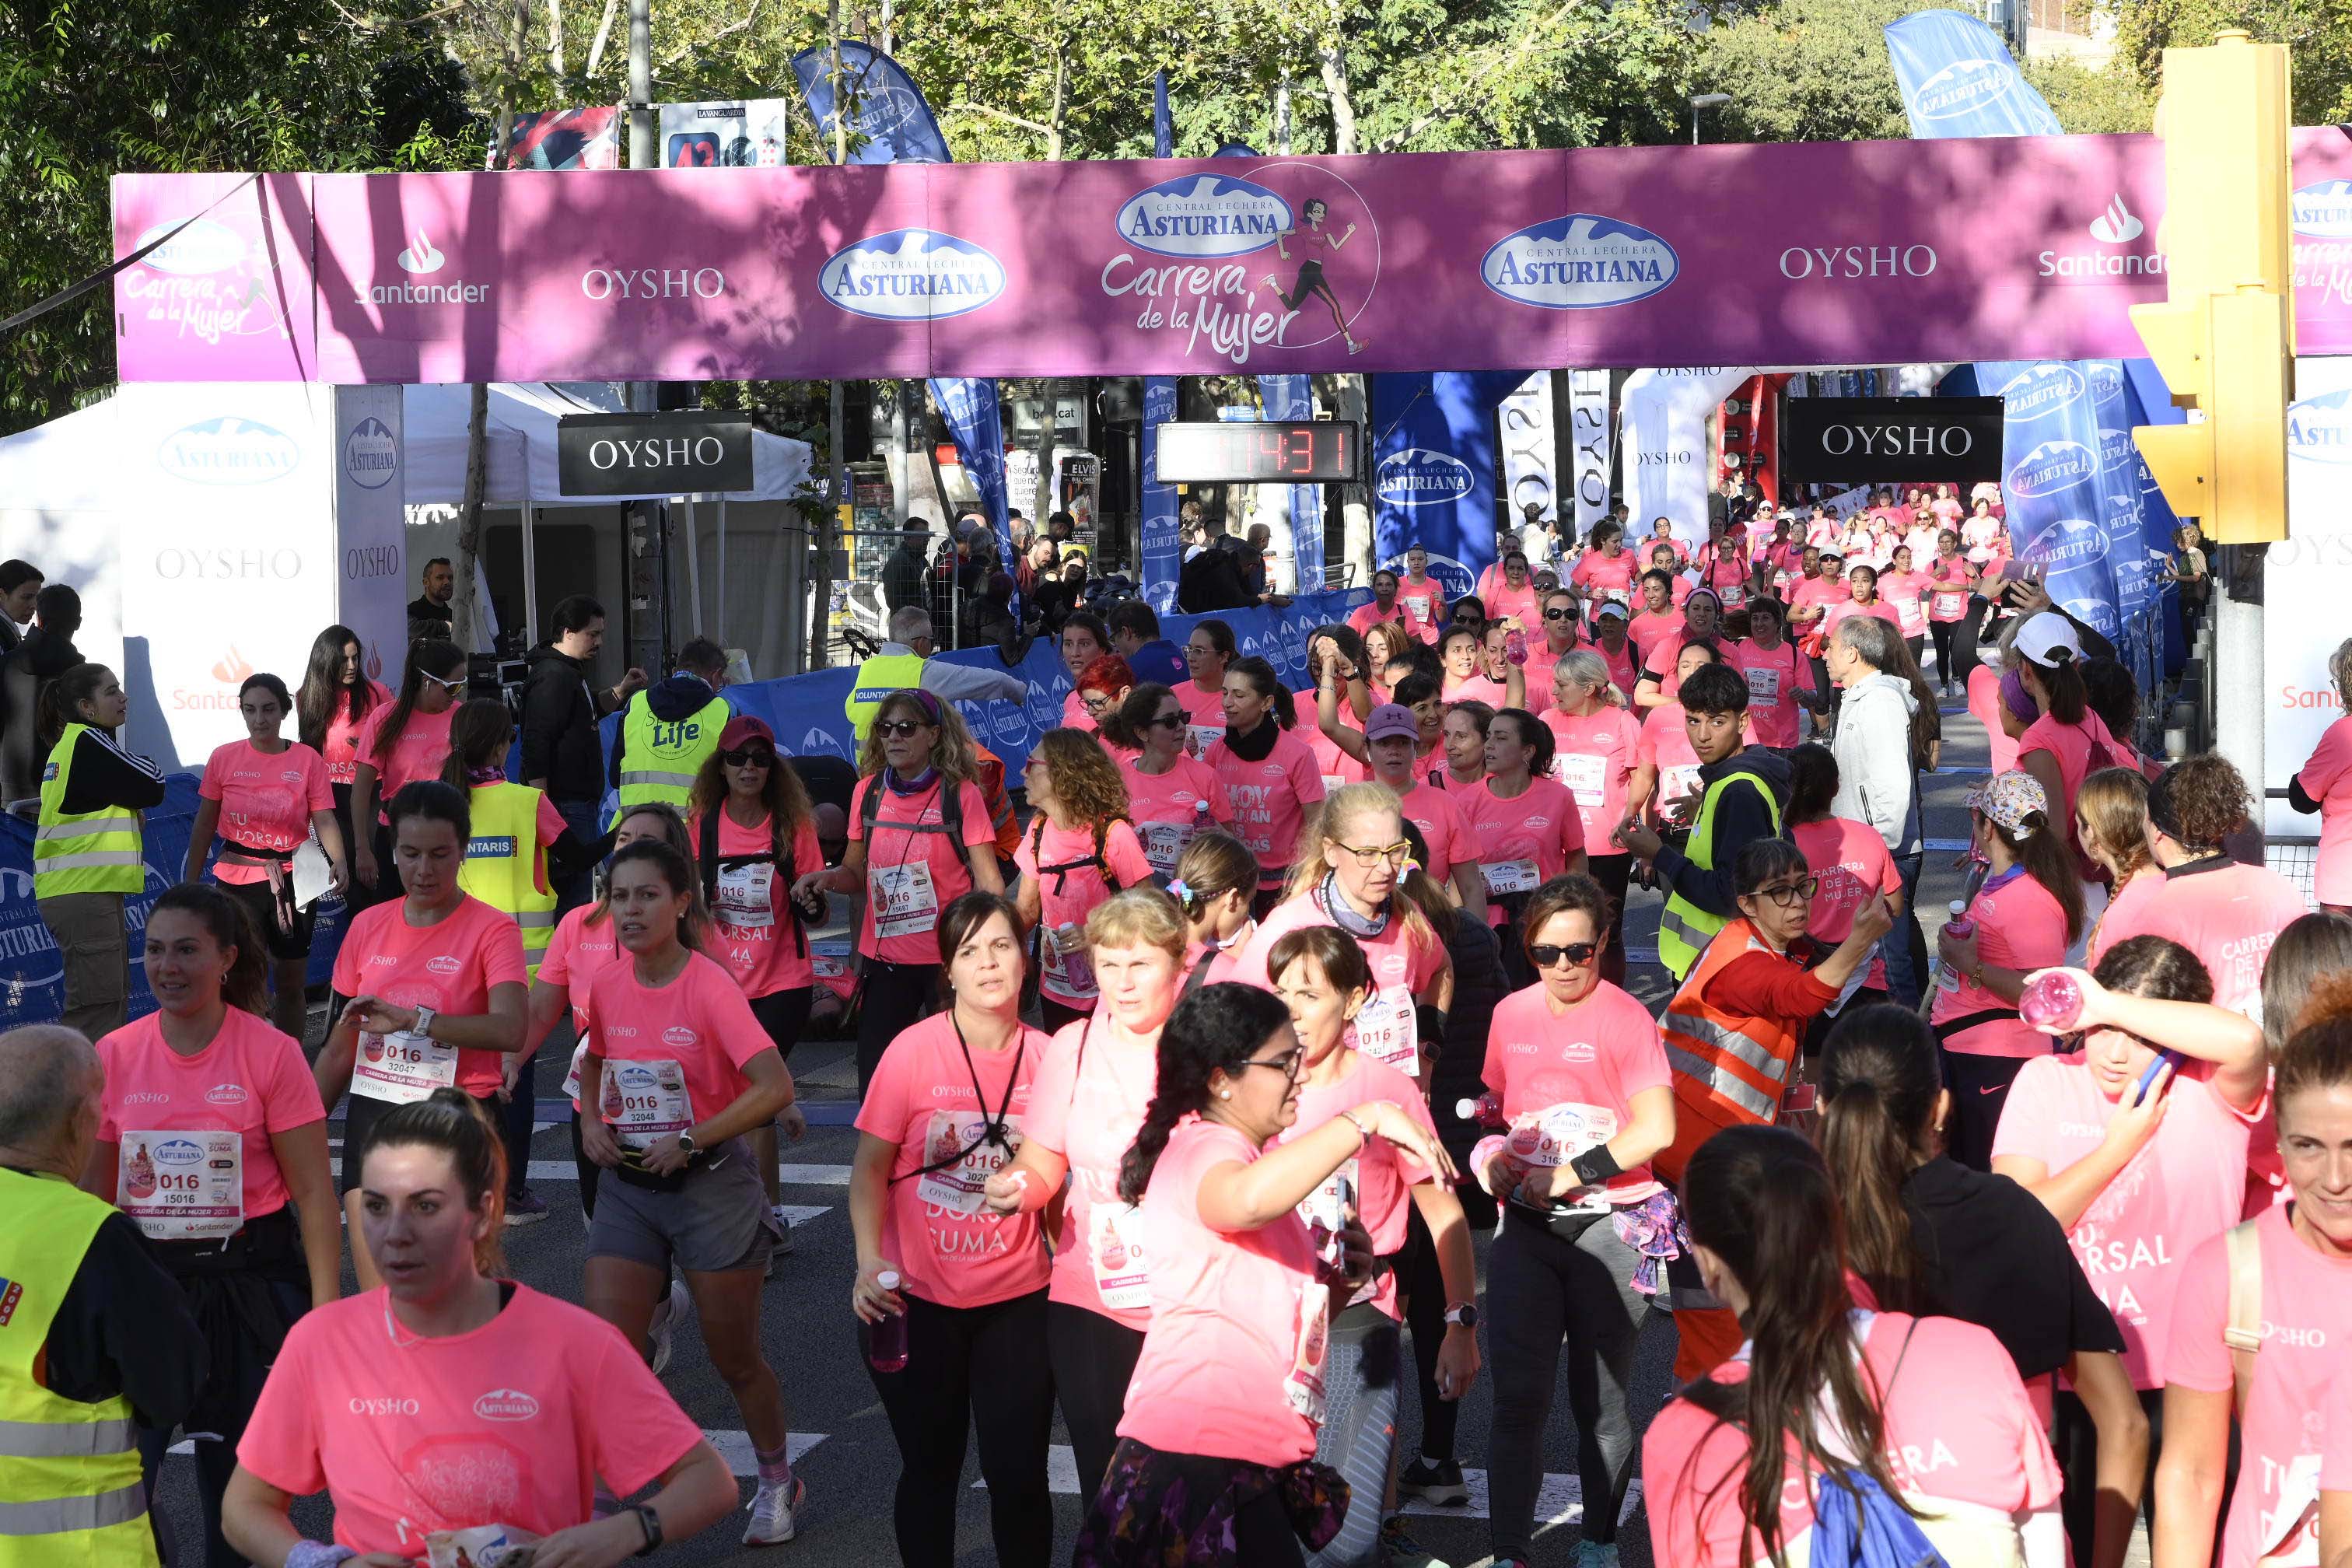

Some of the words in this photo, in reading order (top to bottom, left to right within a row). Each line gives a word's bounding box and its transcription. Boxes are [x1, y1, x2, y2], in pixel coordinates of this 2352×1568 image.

[1157, 201, 1212, 211] CENTRAL
[1218, 201, 1274, 210] LECHERA
[1129, 205, 1279, 237] ASTURIANA
[1526, 247, 1587, 257] CENTRAL
[1593, 245, 1657, 255] LECHERA
[861, 261, 920, 269] CENTRAL
[1495, 251, 1664, 286] ASTURIANA
[1779, 244, 1938, 279] OYSHO
[832, 263, 989, 296] ASTURIANA
[1101, 254, 1247, 297] Carrera
[124, 269, 219, 299] Carrera
[581, 268, 725, 300] OYSHO
[354, 280, 489, 306] Santander
[178, 297, 252, 345] Mujer
[1136, 300, 1164, 329] de
[1169, 297, 1190, 329] la
[1185, 290, 1301, 364] Mujer
[1822, 425, 1972, 456] OYSHO
[348, 443, 394, 471] ASTURIANA
[588, 436, 724, 470] OYSHO
[1633, 450, 1692, 466] OYSHO
[1072, 464, 1096, 474] ELVIS
[1379, 471, 1467, 492] ASTURIANA
[156, 548, 302, 579] OYSHO
[346, 544, 398, 582] OYSHO
[652, 719, 699, 749] Life
[229, 812, 247, 826] TU
[1475, 821, 1502, 832] OYSHO
[1151, 842, 1174, 854] 016
[1812, 861, 1865, 878] CARRERA
[1494, 881, 1517, 893] 016
[1825, 879, 1843, 890] DE
[1844, 876, 1858, 886] LA
[722, 887, 744, 897] 016
[888, 891, 910, 904] 016
[1824, 887, 1862, 902] MUJER
[892, 905, 909, 913] 15687
[579, 941, 614, 952] OYSHO
[607, 1026, 637, 1038] OYSHO
[1362, 1028, 1391, 1045] 016
[387, 1045, 422, 1062] 016
[388, 1062, 415, 1075] 32047
[365, 1069, 388, 1081] CARRERA
[407, 1077, 428, 1088] MUJER
[360, 1080, 387, 1094] OYSHO
[932, 1086, 978, 1097] OYSHO
[124, 1091, 170, 1105] OYSHO
[625, 1095, 658, 1110] 016
[631, 1112, 656, 1122] 32048
[1541, 1138, 1576, 1154] 016
[157, 1150, 201, 1160] ASTURIANA
[964, 1153, 1001, 1169] 016
[160, 1174, 200, 1190] 016
[936, 1174, 965, 1190] CARRERA
[965, 1182, 976, 1192] DE
[165, 1194, 195, 1204] 15016
[929, 1188, 963, 1204] OYSHO
[349, 1398, 420, 1416] OYSHO
[480, 1401, 534, 1414] ASTURIANA
